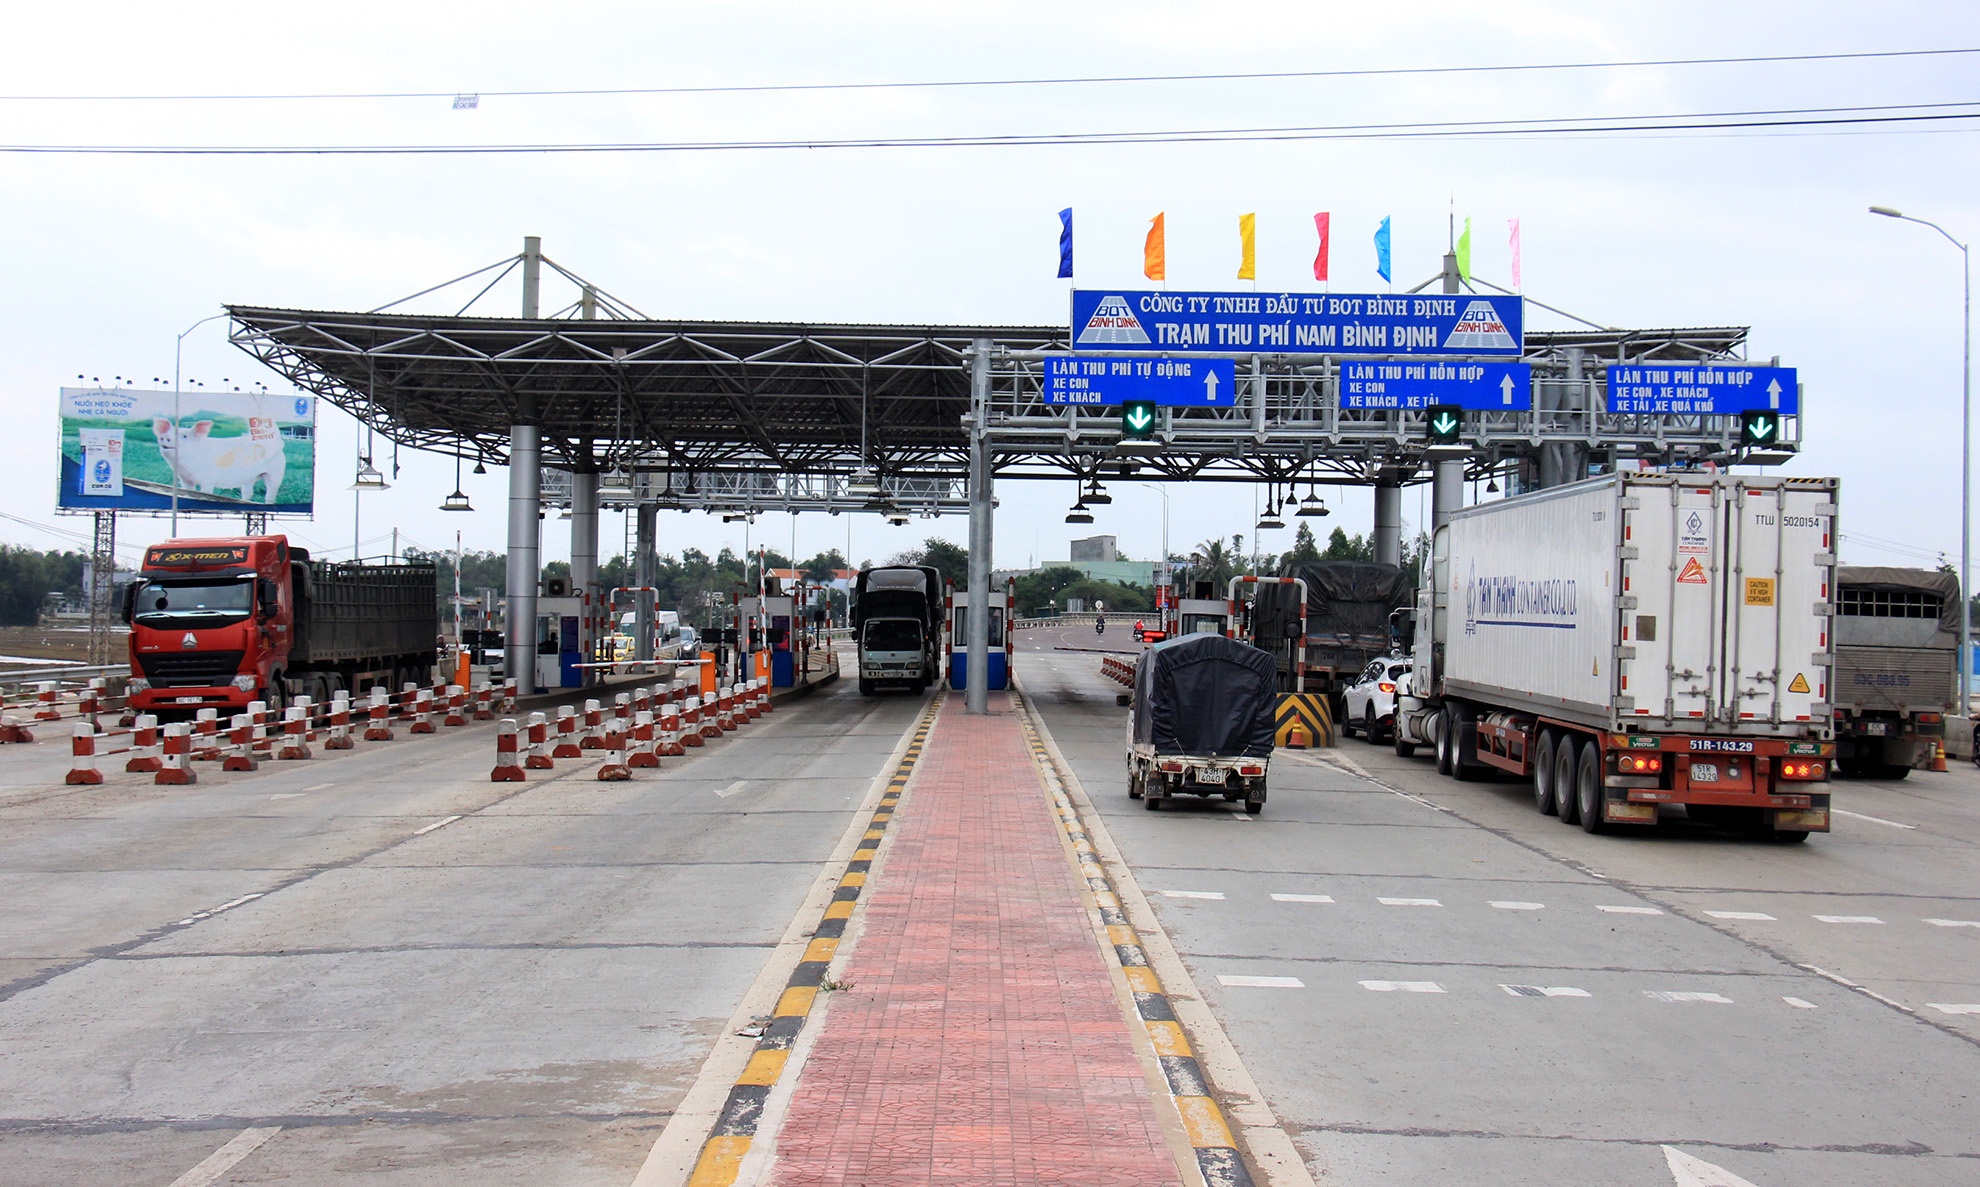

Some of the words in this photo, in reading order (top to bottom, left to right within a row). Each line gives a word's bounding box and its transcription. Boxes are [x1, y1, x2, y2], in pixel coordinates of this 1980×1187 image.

[1095, 306, 1128, 316] BOT
[1139, 292, 1183, 313] CÔNG
[1187, 299, 1209, 313] TY
[1212, 299, 1259, 314] TNHH
[1265, 293, 1298, 315] ĐẦU
[1302, 295, 1324, 316] TƯ
[1328, 299, 1362, 316] BOT
[1366, 295, 1407, 316] BÌNH
[1413, 300, 1455, 319] ĐỊNH
[1461, 311, 1494, 321] BOT
[1155, 322, 1209, 348] TRẠM
[1215, 324, 1251, 345] THU
[1258, 319, 1290, 346] PHÍ
[1295, 325, 1336, 346] NAM
[1342, 320, 1386, 347] BÌNH
[1393, 325, 1437, 351] ĐỊNH
[1052, 359, 1078, 375] LÀN
[1082, 362, 1106, 375] THU
[1111, 360, 1132, 376] PHÍ
[1136, 361, 1153, 379] TỰ
[1156, 360, 1191, 379] ĐỘNG
[1349, 365, 1374, 379] LÀN
[1378, 366, 1402, 380] THU
[1405, 363, 1426, 380] PHÍ
[1429, 361, 1456, 381] HỖN
[1459, 367, 1485, 384] HỢP
[1053, 378, 1066, 388] XE
[1069, 378, 1089, 389] CON
[1615, 367, 1642, 384] LÀN
[1645, 370, 1669, 384] THU
[1674, 368, 1695, 385] PHÍ
[1698, 366, 1724, 385] HỖN
[1727, 370, 1754, 388] HỢP
[1349, 382, 1363, 393] XE
[1365, 382, 1385, 394] CON
[1616, 386, 1630, 397] XE
[1660, 387, 1674, 398] XE
[1676, 385, 1709, 398] KHÁCH
[1053, 391, 1066, 402] XE
[1069, 390, 1102, 403] KHÁCH
[1349, 396, 1363, 407] XE
[1407, 397, 1420, 407] XE
[1616, 400, 1630, 411] XE
[1671, 399, 1691, 412] QUÁ
[1756, 515, 1774, 526] TTLU
[1783, 516, 1819, 528] 5020154
[1690, 739, 1753, 753] 51R-143.29
[1204, 767, 1219, 776] 43H
[1697, 764, 1711, 773] 51R
[1201, 775, 1221, 783] 4040
